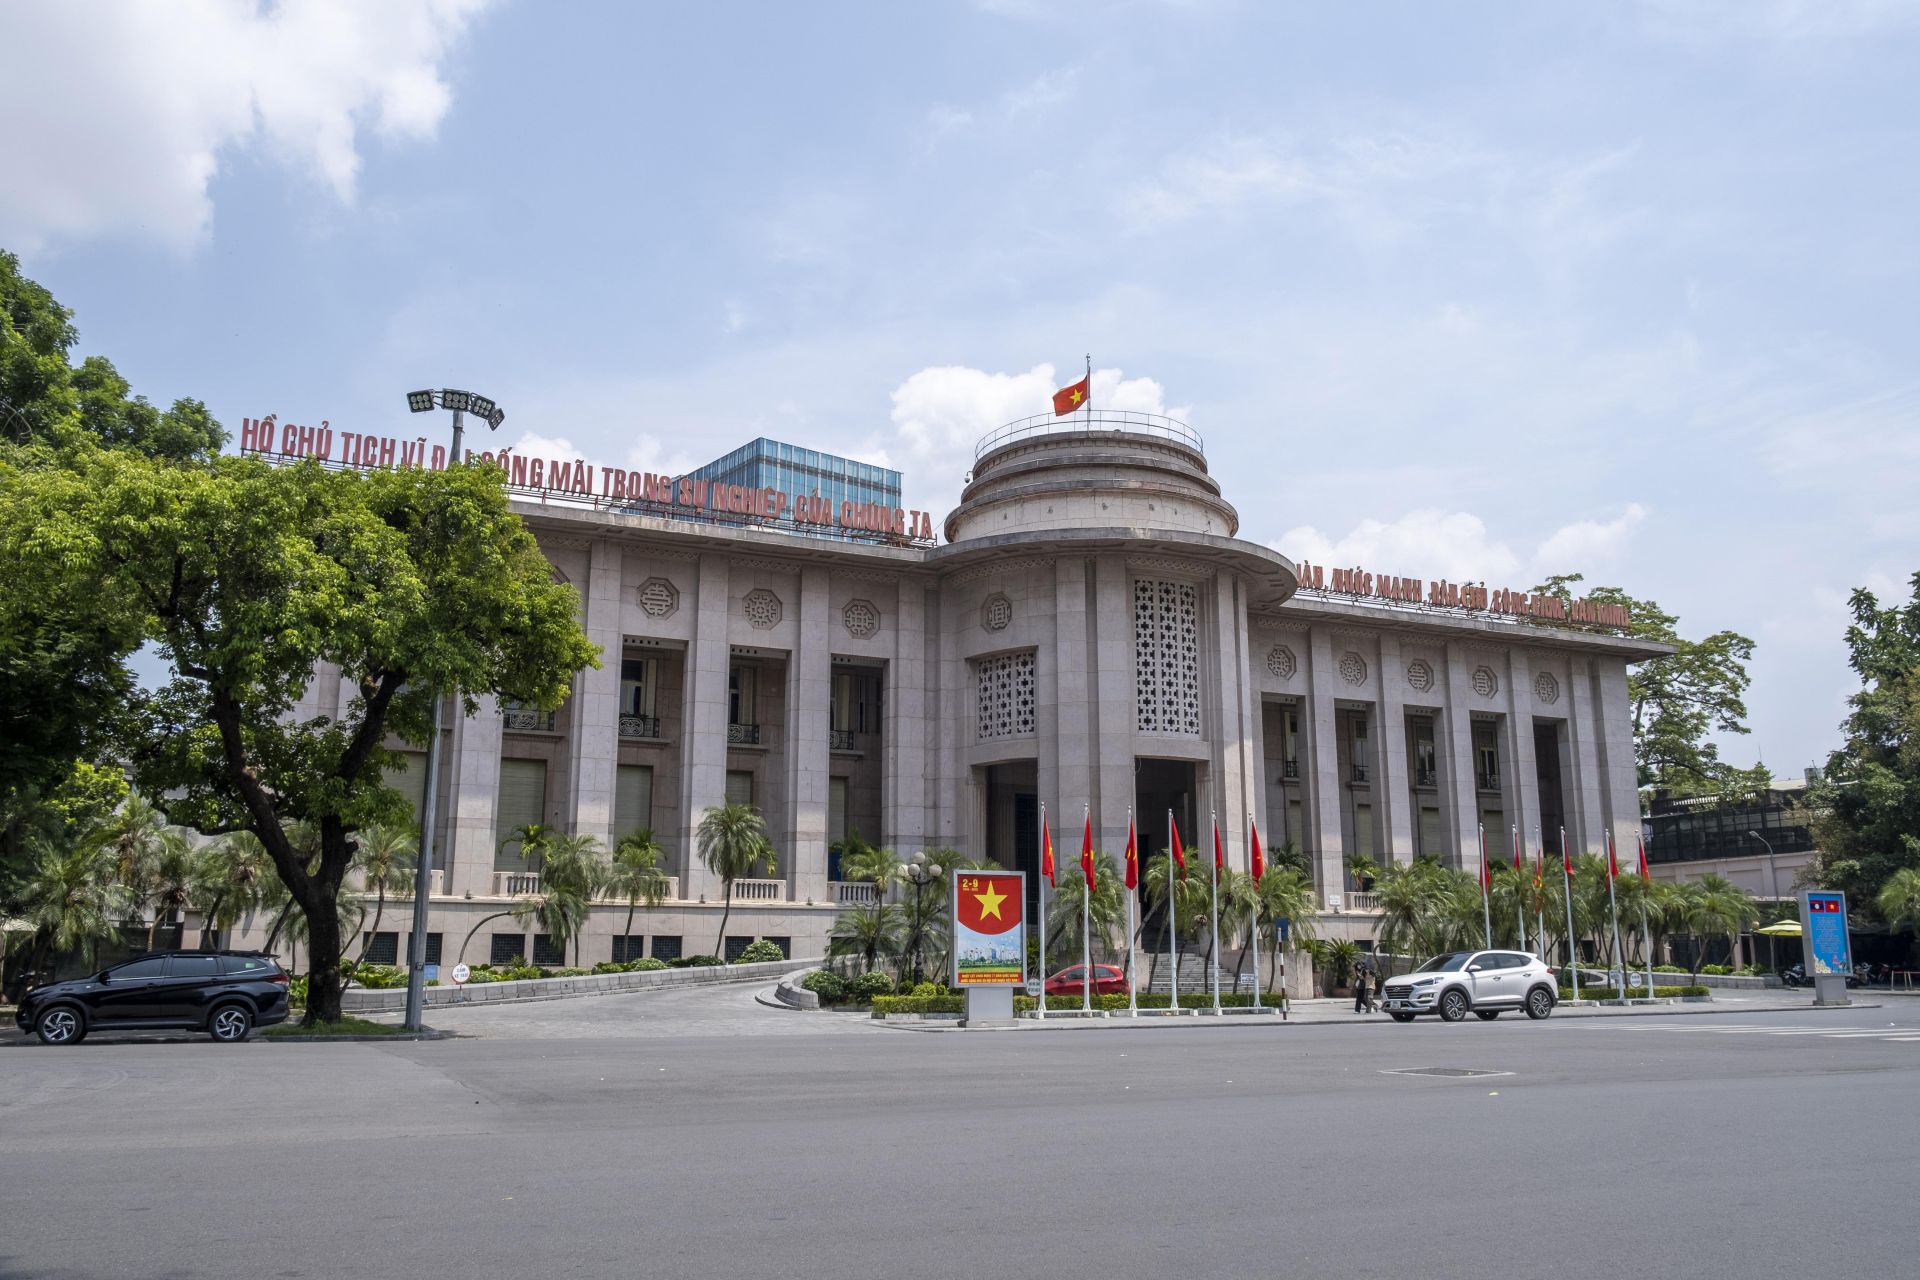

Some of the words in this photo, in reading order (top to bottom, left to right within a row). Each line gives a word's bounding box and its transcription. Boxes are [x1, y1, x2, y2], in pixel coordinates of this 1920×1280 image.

[241, 413, 278, 452] HỒ
[281, 420, 333, 461] CHỦ
[402, 436, 427, 471] VĨ
[549, 458, 593, 495] MÃI
[601, 466, 672, 504] TRONG
[712, 481, 787, 521] NGHIỆP
[794, 488, 833, 525] CỦA
[840, 500, 905, 535] CHÚNG
[910, 509, 933, 539] TA
